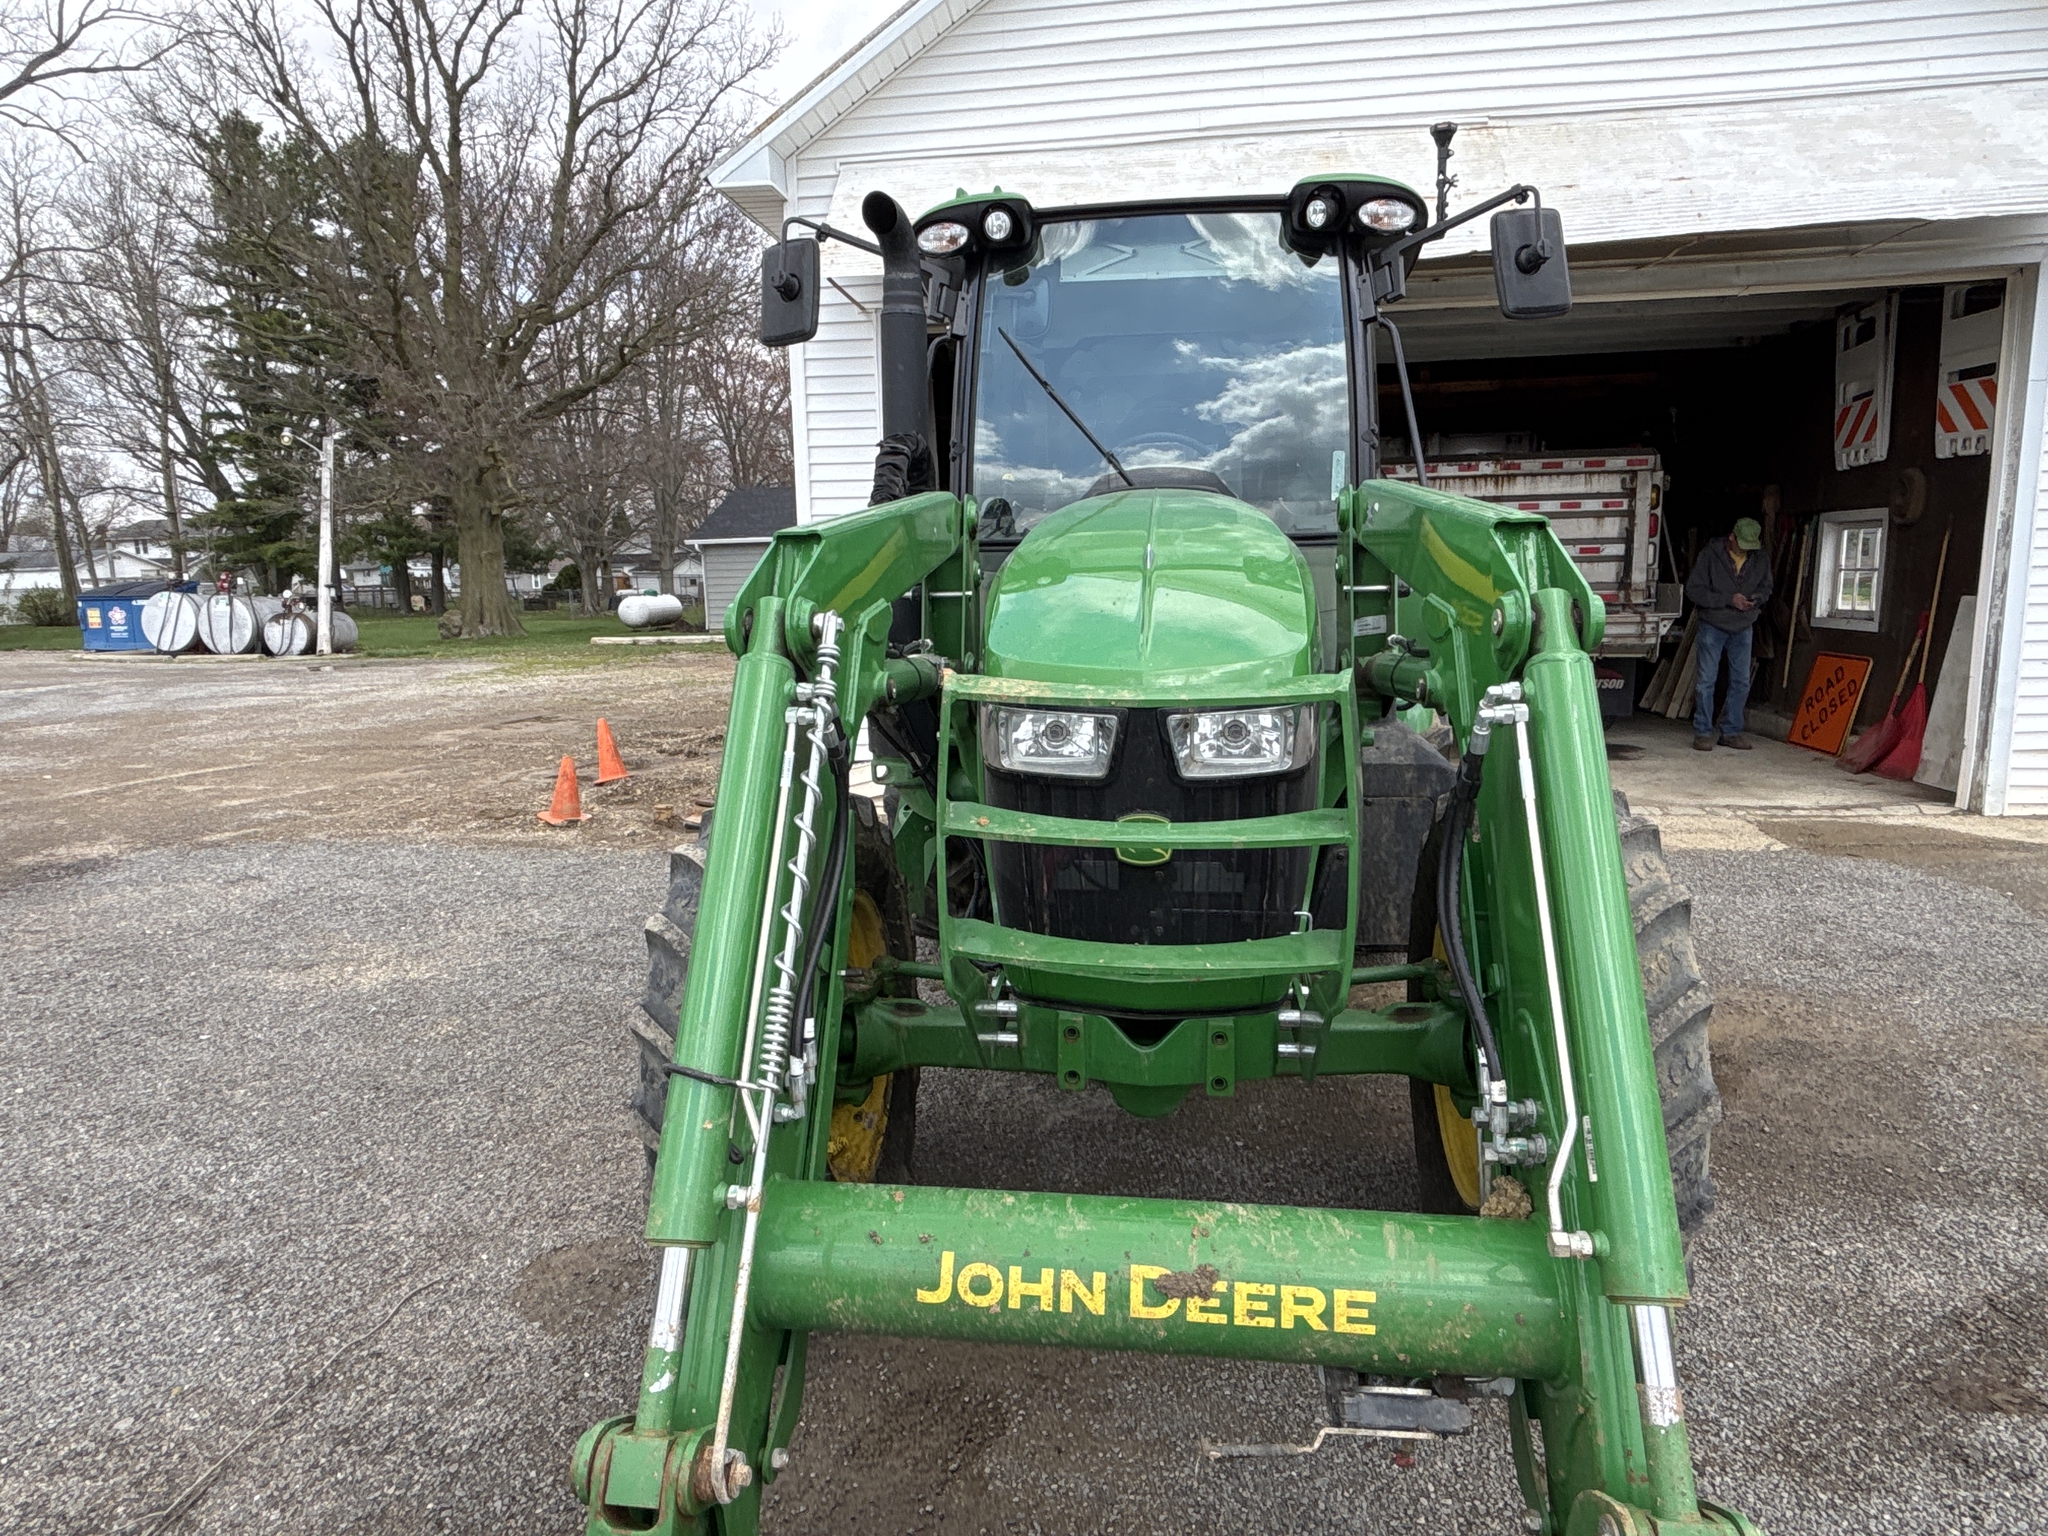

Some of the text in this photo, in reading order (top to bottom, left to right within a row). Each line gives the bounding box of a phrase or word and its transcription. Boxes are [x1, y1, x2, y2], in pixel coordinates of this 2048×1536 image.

[1595, 678, 1625, 689] rson
[1801, 679, 1857, 740] CLOSED
[1805, 666, 1845, 713] ROAD
[916, 1251, 1376, 1335] JOHN DEERE
